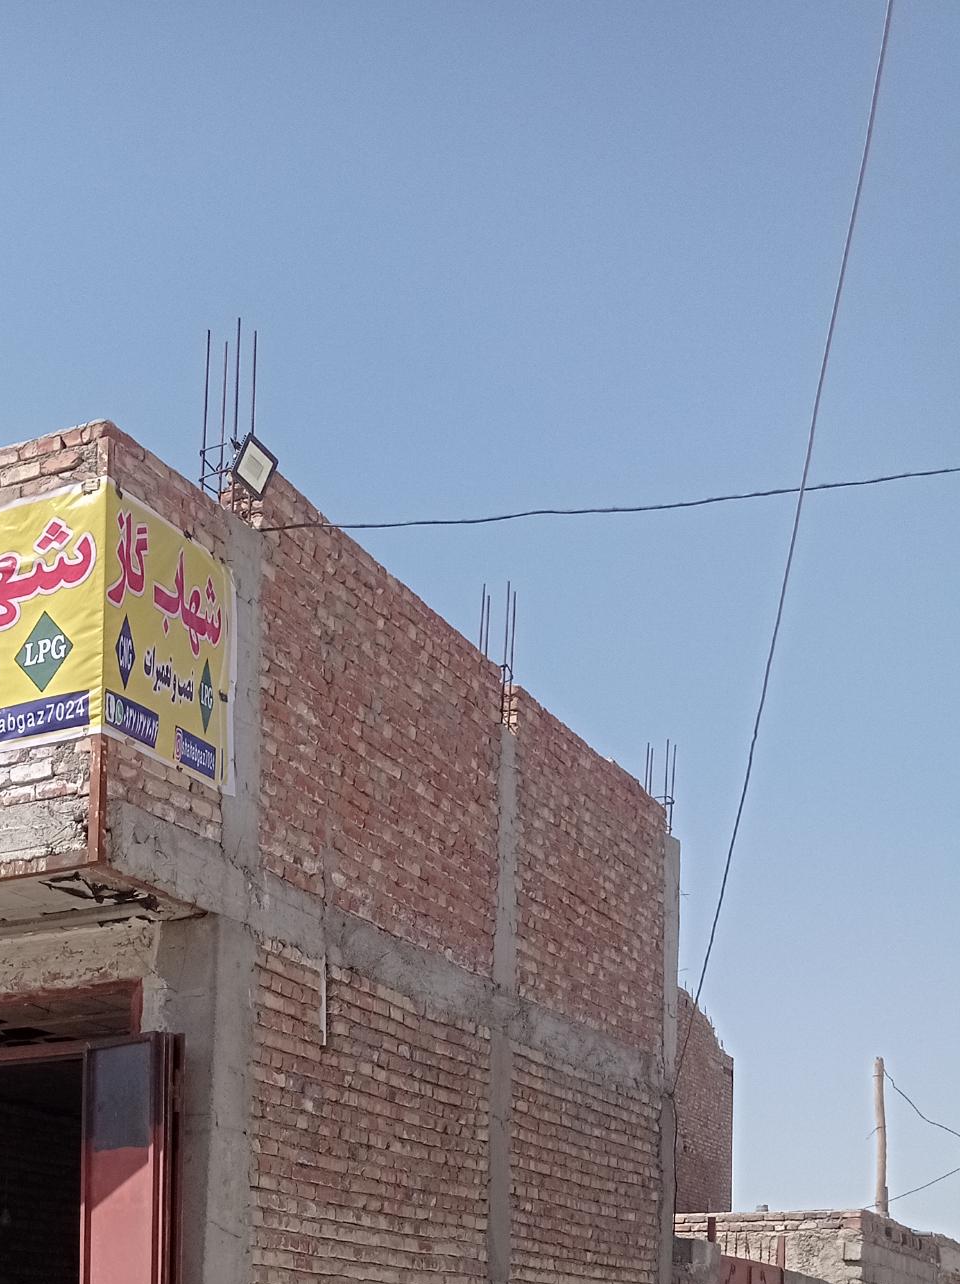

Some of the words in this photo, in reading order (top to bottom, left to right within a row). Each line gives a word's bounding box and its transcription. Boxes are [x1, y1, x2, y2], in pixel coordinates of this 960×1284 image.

[107, 512, 148, 605] گاز
[153, 550, 222, 656] شهاب
[24, 633, 68, 667] LPG
[118, 633, 134, 671] CNG
[199, 684, 213, 709] LPG
